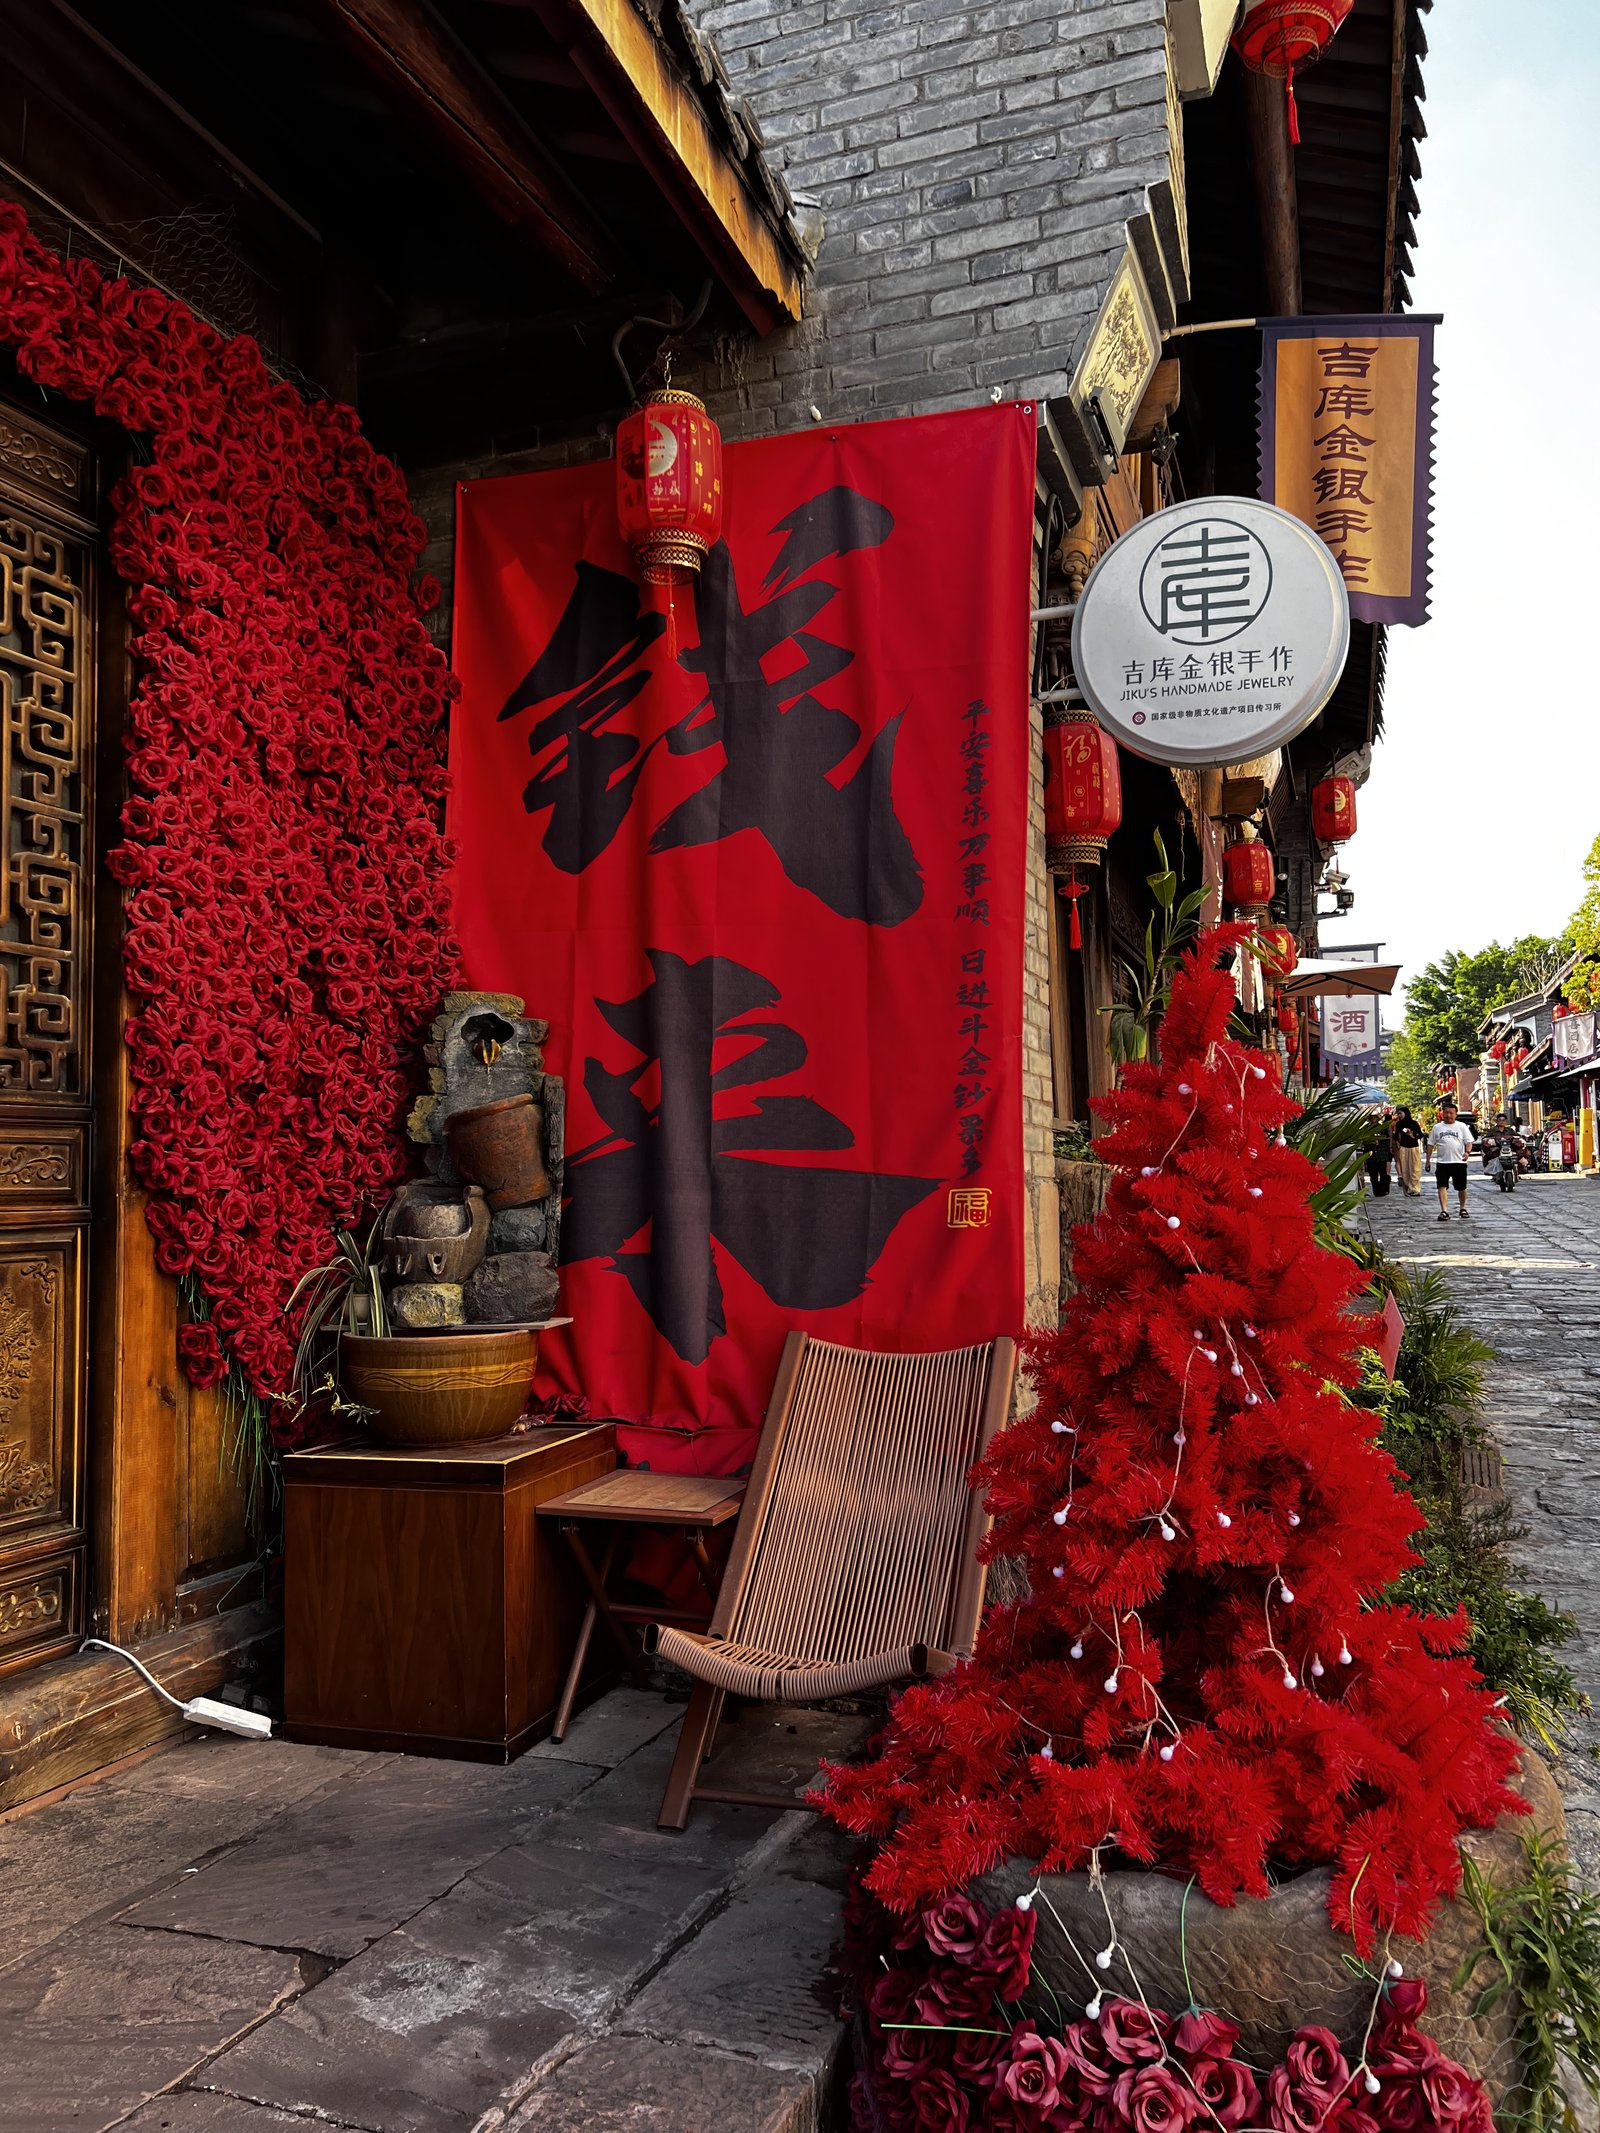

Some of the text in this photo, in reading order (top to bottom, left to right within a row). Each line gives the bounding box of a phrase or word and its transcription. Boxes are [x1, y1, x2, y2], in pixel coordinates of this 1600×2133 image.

[1121, 645, 1294, 686] 吉库金银手作
[1120, 675, 1295, 702] JIKU'S HANDMADE JEWELRY
[1151, 702, 1282, 722] 国家级非物质文化遗产项目传习所
[953, 698, 992, 1181] 平安喜乐万事顺 日进斗金钞票多
